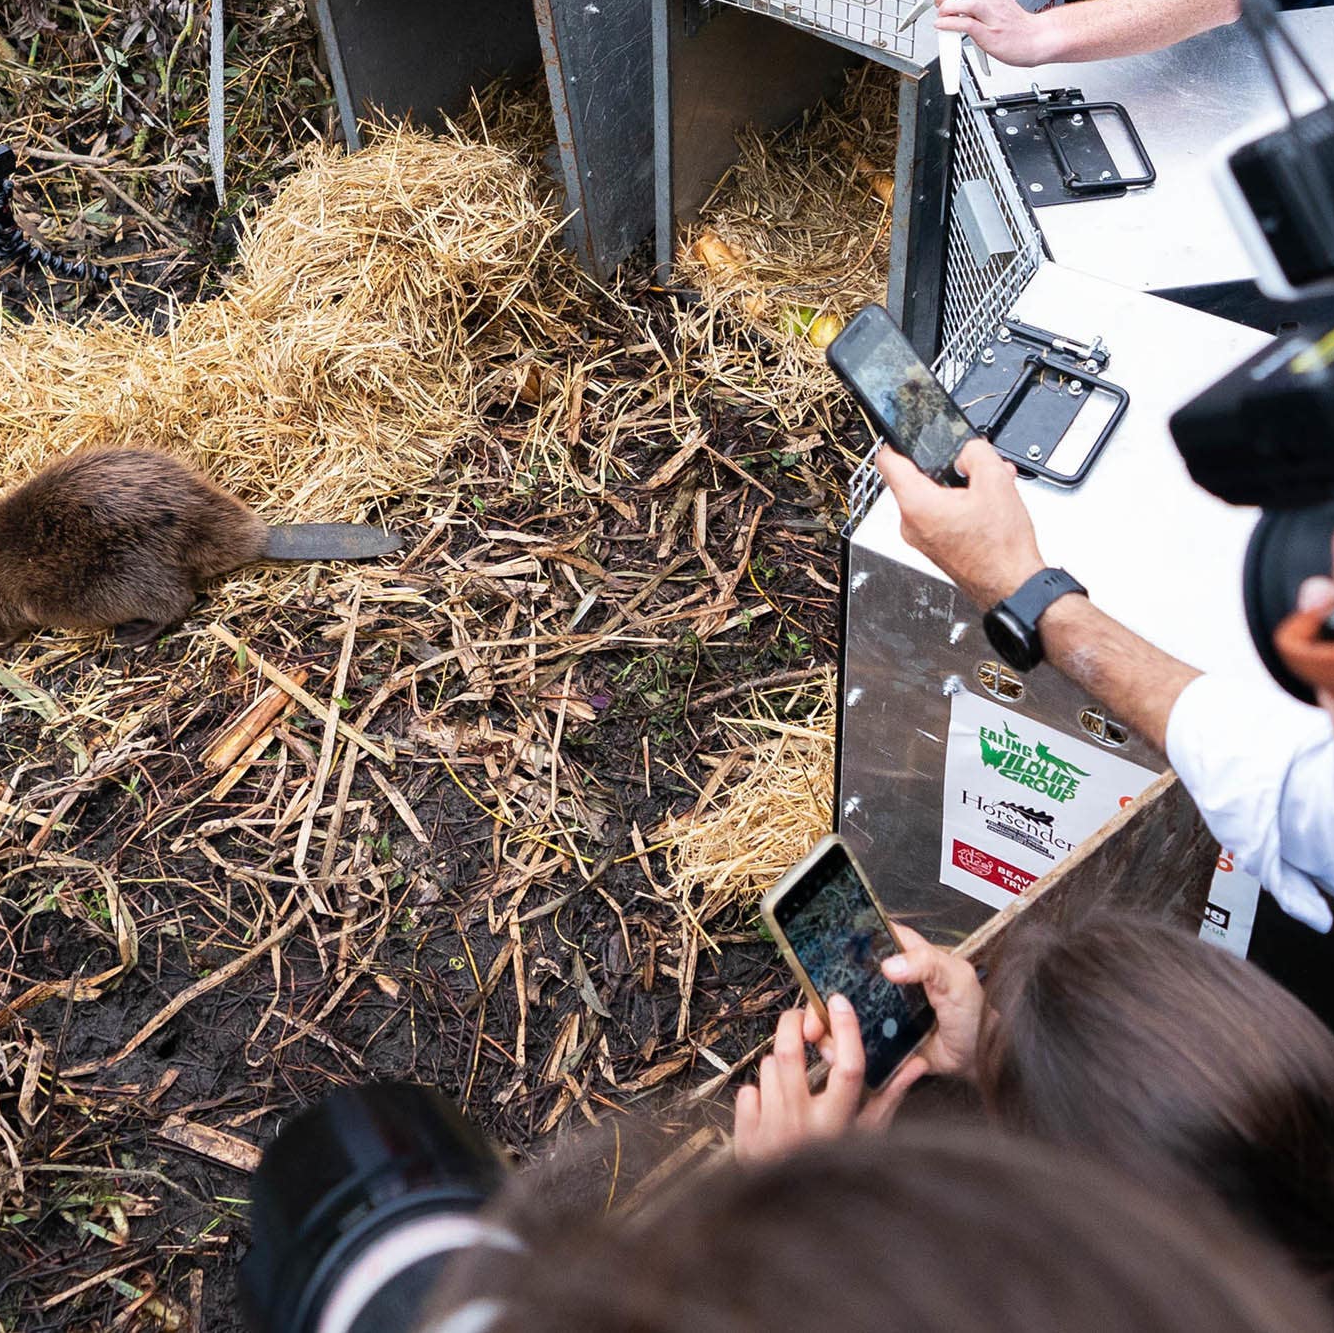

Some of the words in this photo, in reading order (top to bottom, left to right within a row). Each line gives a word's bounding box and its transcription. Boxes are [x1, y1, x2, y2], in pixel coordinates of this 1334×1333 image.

[979, 726, 1033, 759] EALING
[979, 737, 1081, 792] WILDLIFE
[998, 768, 1076, 804] GROUP
[1002, 876, 1027, 893] TRU
